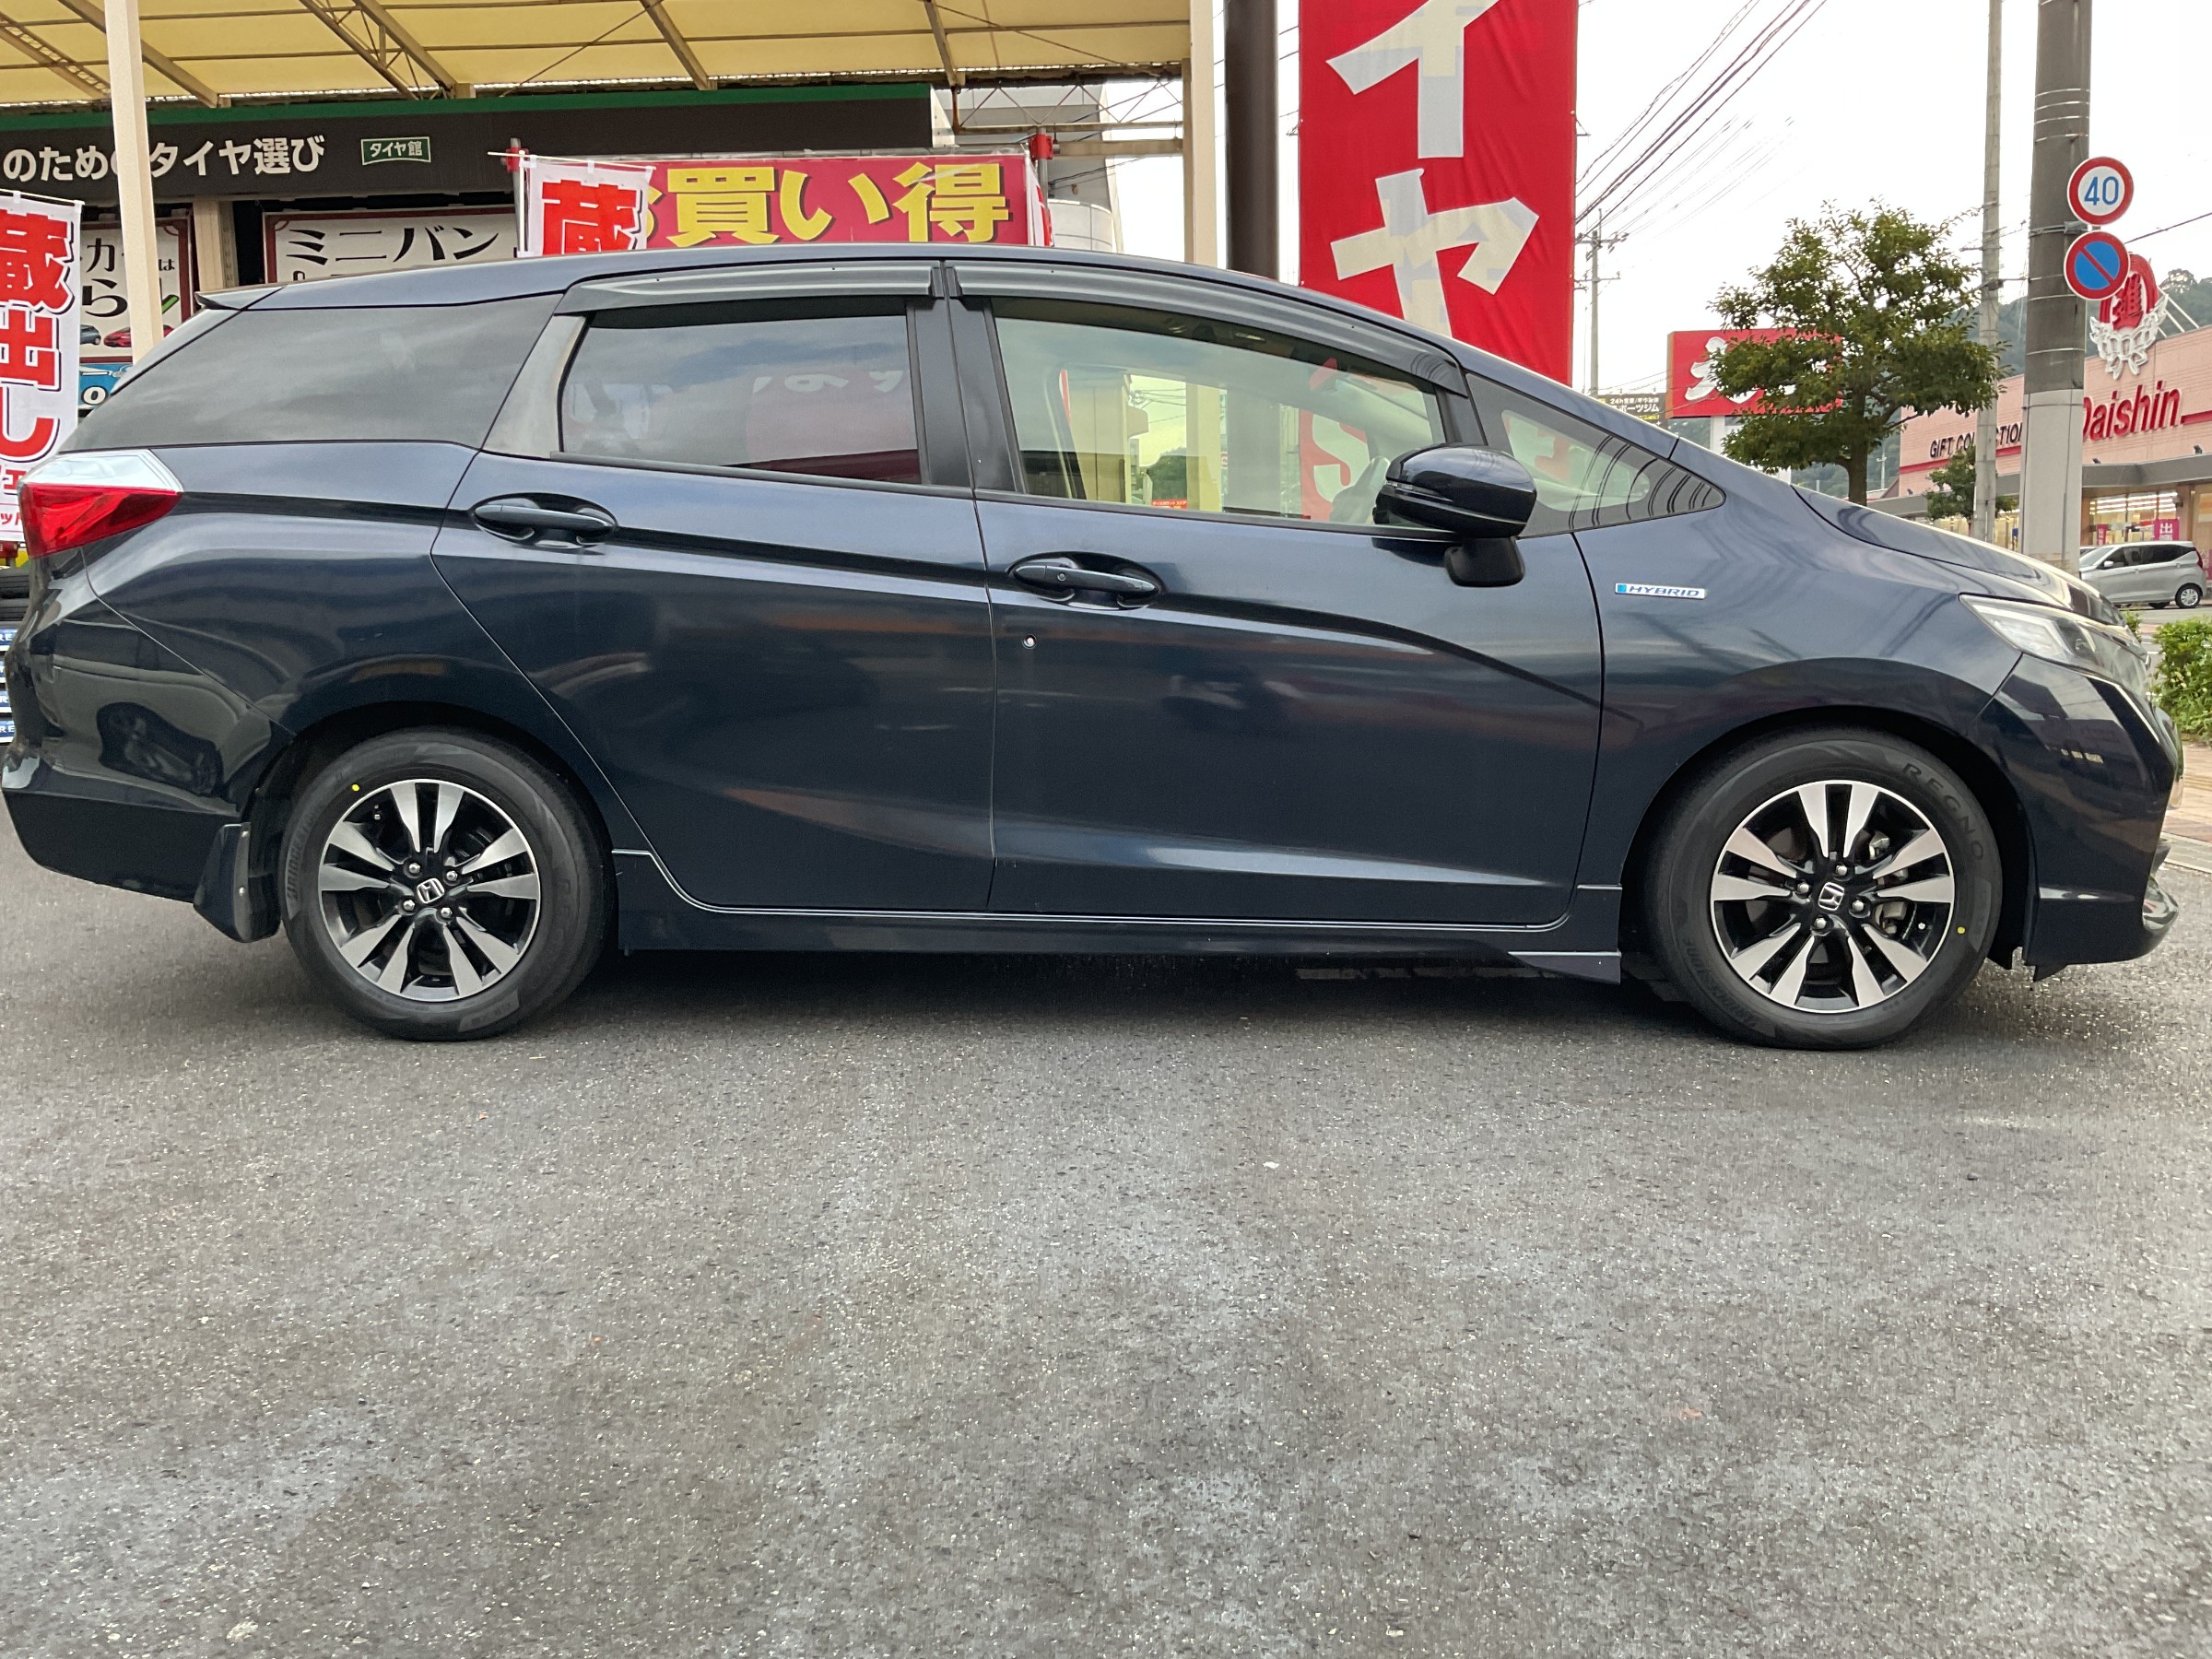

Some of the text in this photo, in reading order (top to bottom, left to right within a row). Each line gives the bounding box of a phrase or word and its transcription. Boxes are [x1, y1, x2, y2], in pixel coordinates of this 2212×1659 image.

[3, 135, 325, 182] のためタイヤ選び
[370, 141, 423, 158] タイヤ館
[647, 162, 1008, 246] 買い得
[2084, 176, 2120, 206] 40
[286, 224, 500, 265] ミニバン
[1930, 437, 1954, 458] GIFT
[1629, 585, 1700, 597] HYBRID
